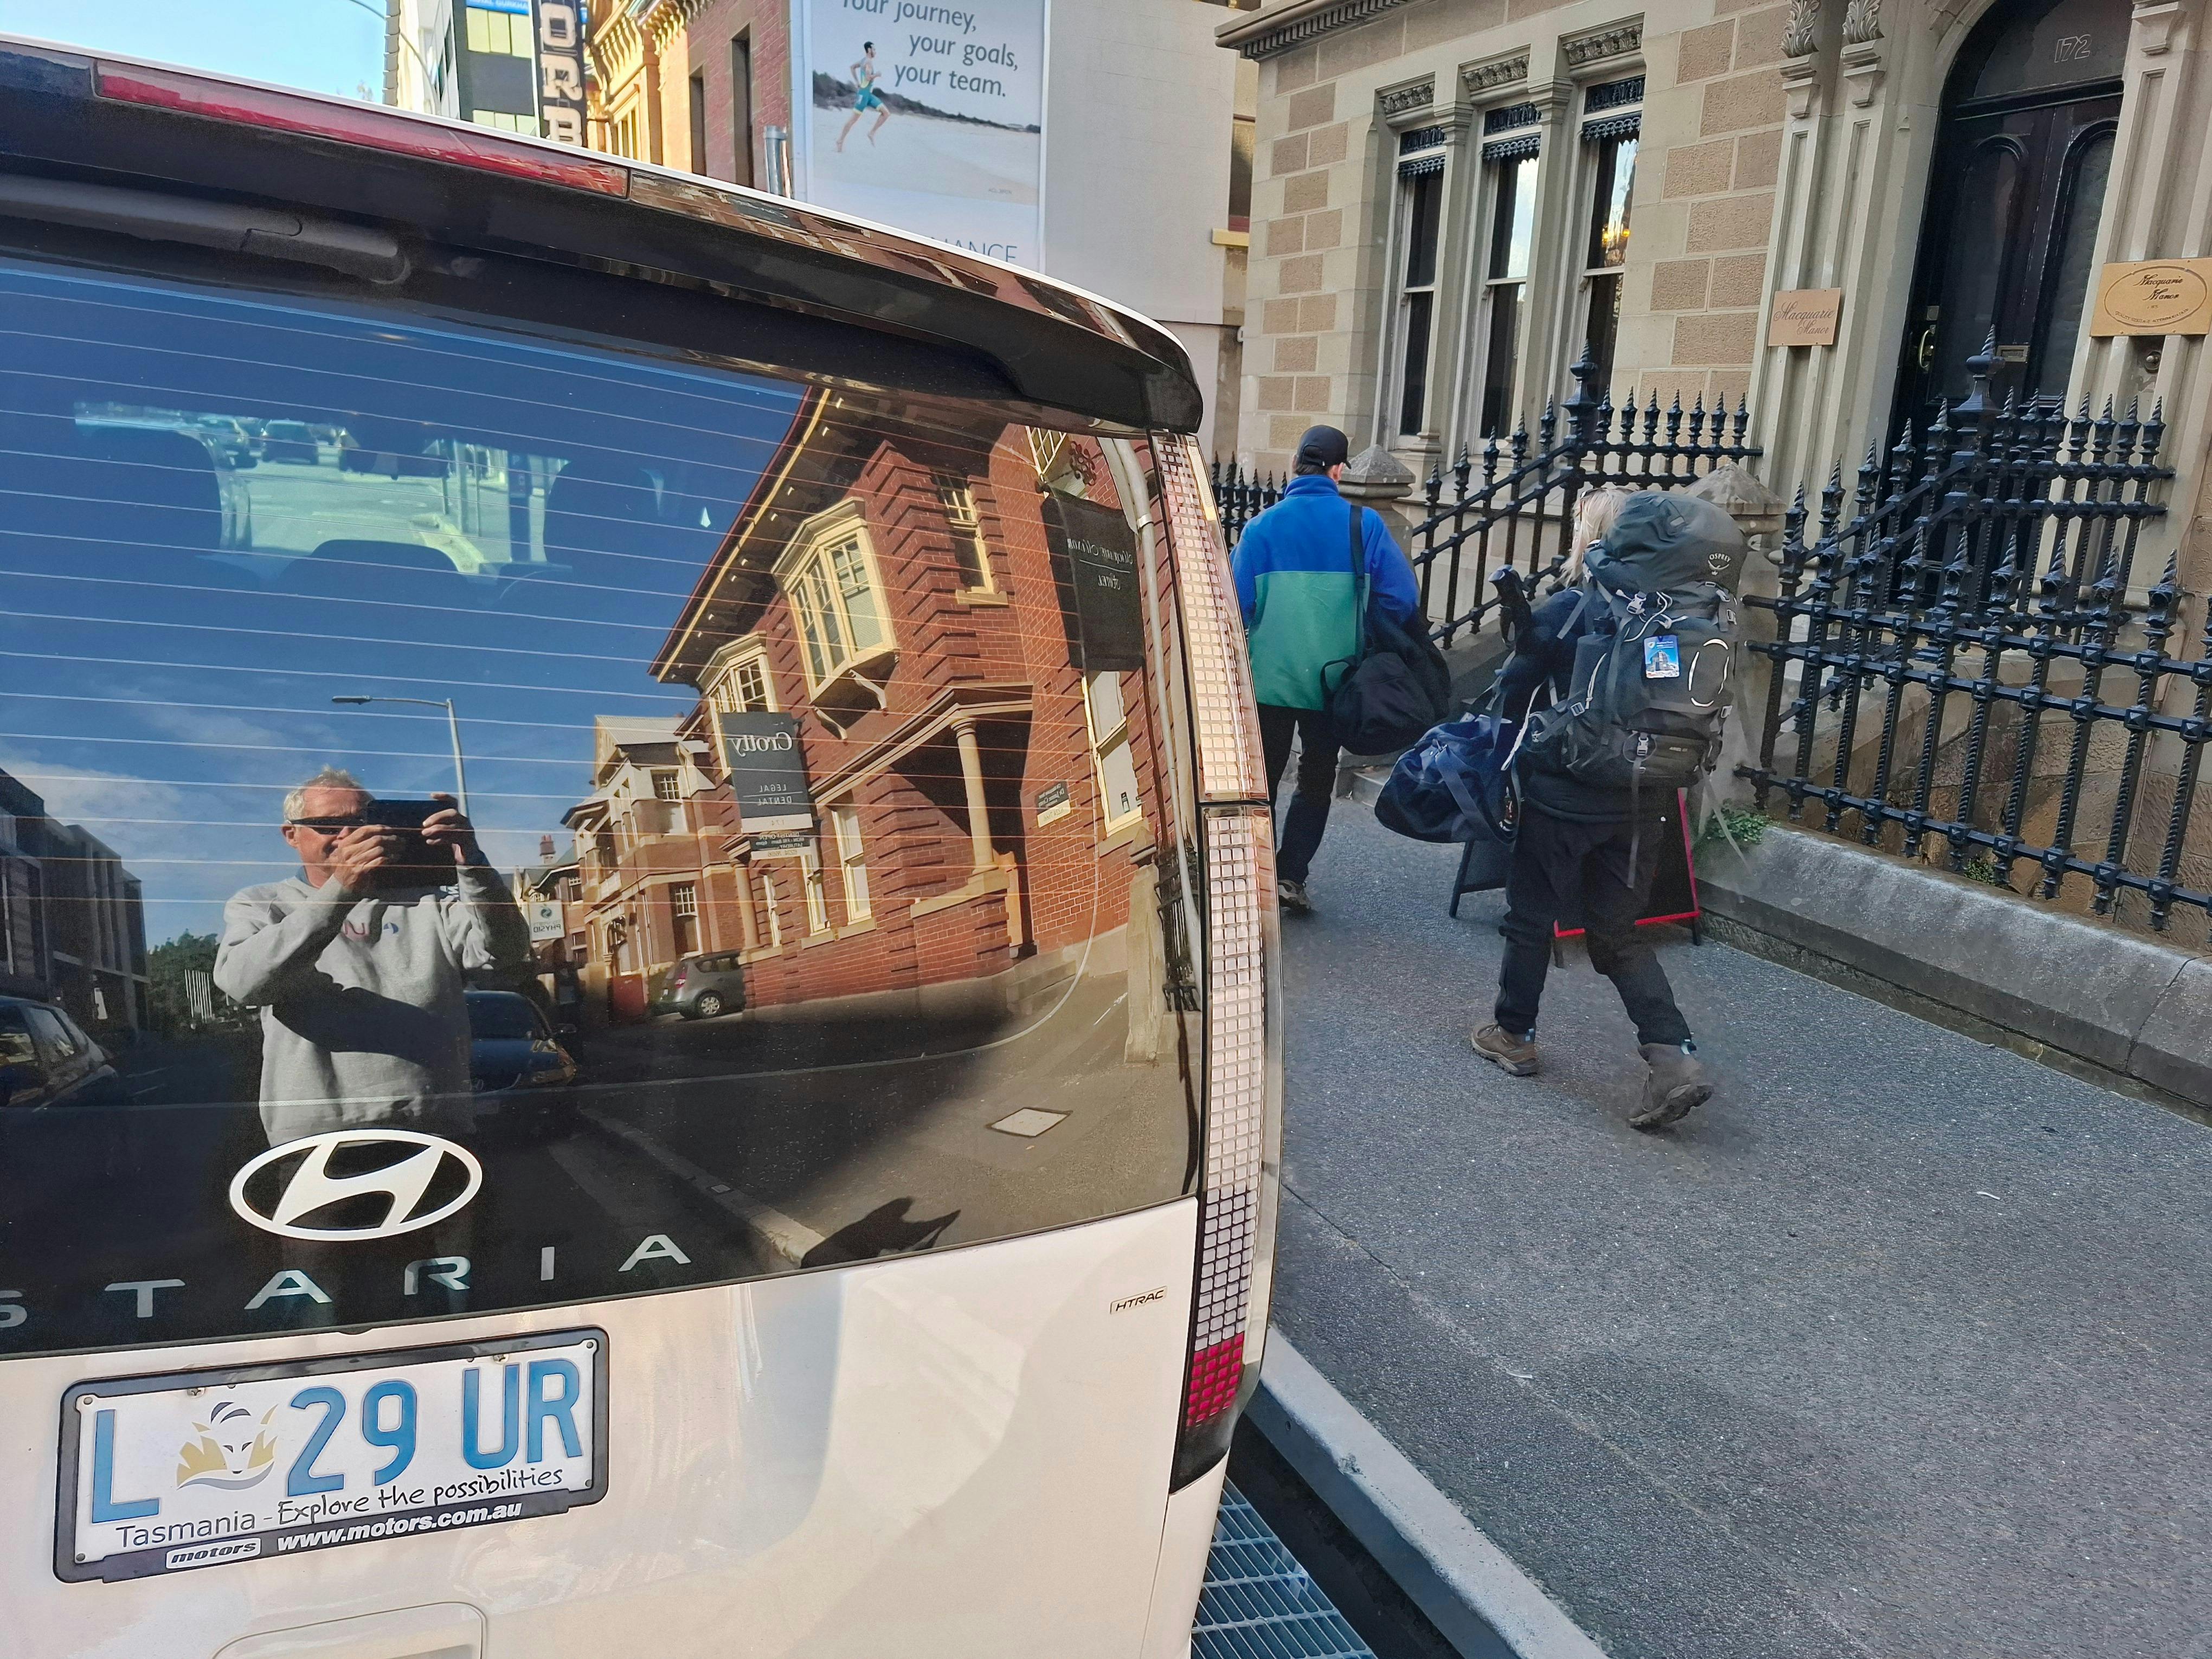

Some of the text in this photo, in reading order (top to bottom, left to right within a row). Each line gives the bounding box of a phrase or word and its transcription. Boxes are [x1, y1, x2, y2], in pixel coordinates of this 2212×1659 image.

[893, 1, 976, 35] journey,
[909, 34, 1018, 72] your goals,
[2054, 34, 2093, 63] 172
[895, 63, 1006, 97] your team.
[2132, 274, 2184, 288] Macquarie
[2142, 288, 2179, 300] Manor
[1773, 301, 1835, 327] Macquarie
[1796, 319, 1830, 335] Manor
[1709, 552, 1732, 563] OSPREY
[1115, 1290, 1165, 1311] HTRAC
[91, 1358, 583, 1523] L 29 UR
[115, 1510, 255, 1547] Tasmania
[277, 1494, 370, 1525] Explore
[378, 1485, 425, 1509] the
[433, 1468, 563, 1506] possibilities
[171, 1502, 522, 1564] motors www.motors.com.au
